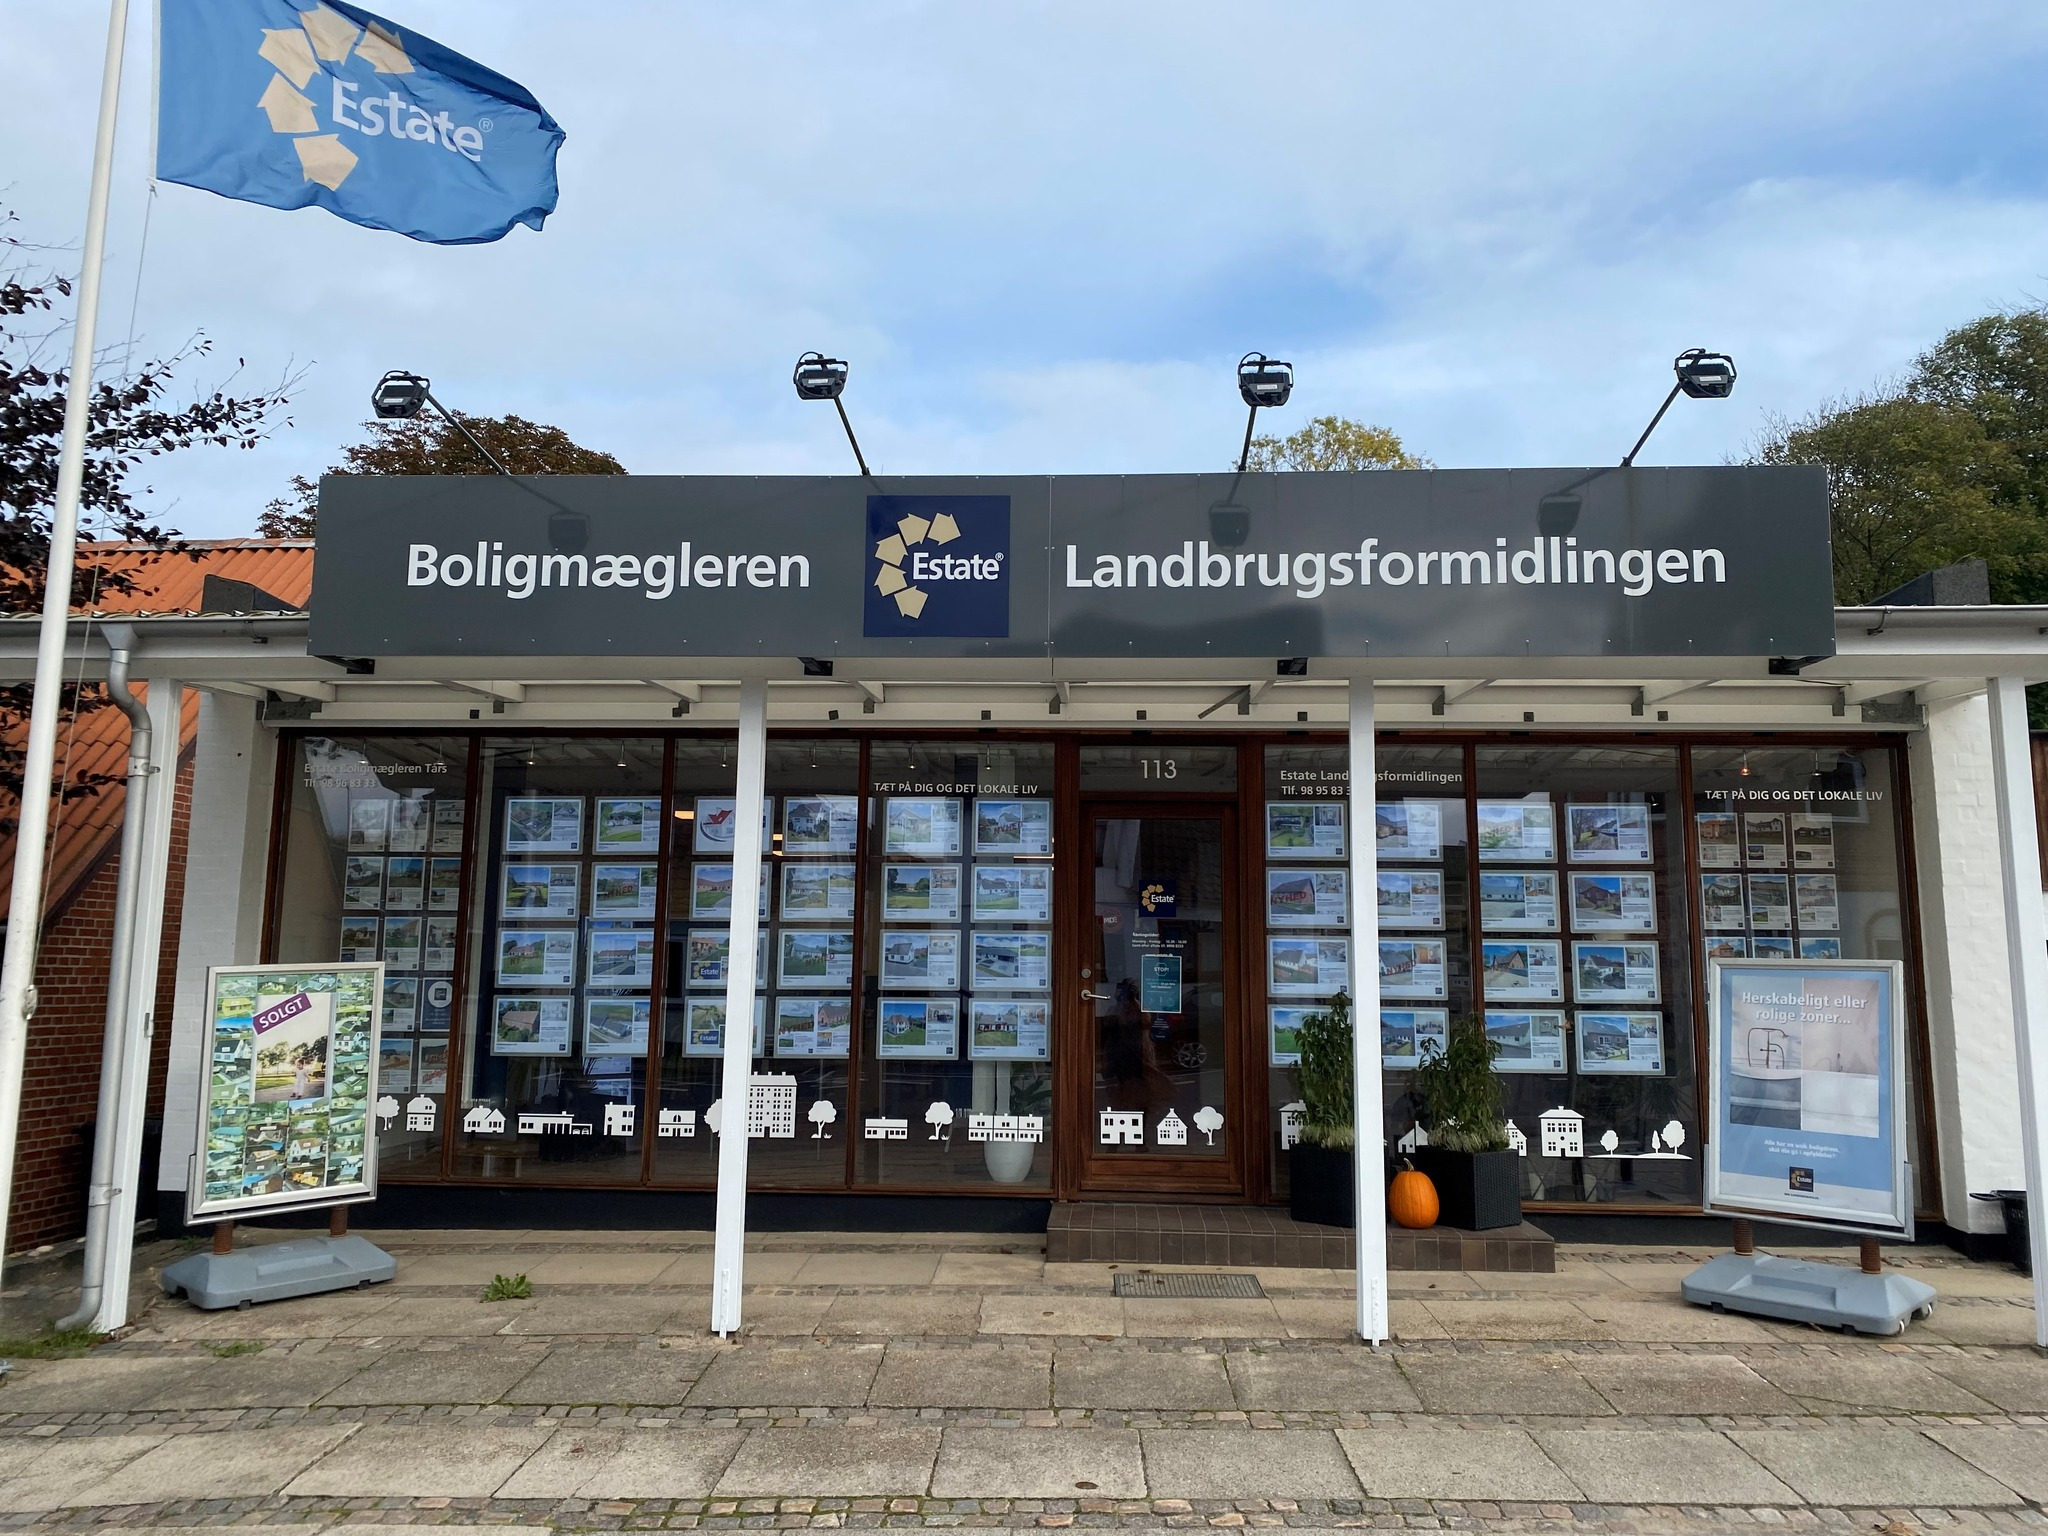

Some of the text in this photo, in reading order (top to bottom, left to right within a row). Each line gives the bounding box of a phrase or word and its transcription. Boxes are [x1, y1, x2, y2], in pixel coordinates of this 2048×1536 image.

[406, 541, 810, 600] Boligmægleren
[1066, 537, 1726, 598] Landbrugsformidlingen
[340, 763, 422, 775] Boligmægleren
[1140, 760, 1177, 779] 113
[1280, 770, 1317, 780] Estate
[874, 781, 1038, 794] TÆT PÅ DIG OG DET LOKALE LIV
[1282, 786, 1298, 795] Tlf.
[1301, 786, 1313, 795] 98
[1316, 786, 1328, 795] 95
[1331, 786, 1343, 795] 83
[1704, 787, 1883, 800] TÆT PÅ DIG OG DET LOKALE LIV
[1742, 991, 1867, 1009] Herskabeligt eller
[258, 997, 304, 1029] SOLGT
[1756, 1006, 1796, 1024] rolige
